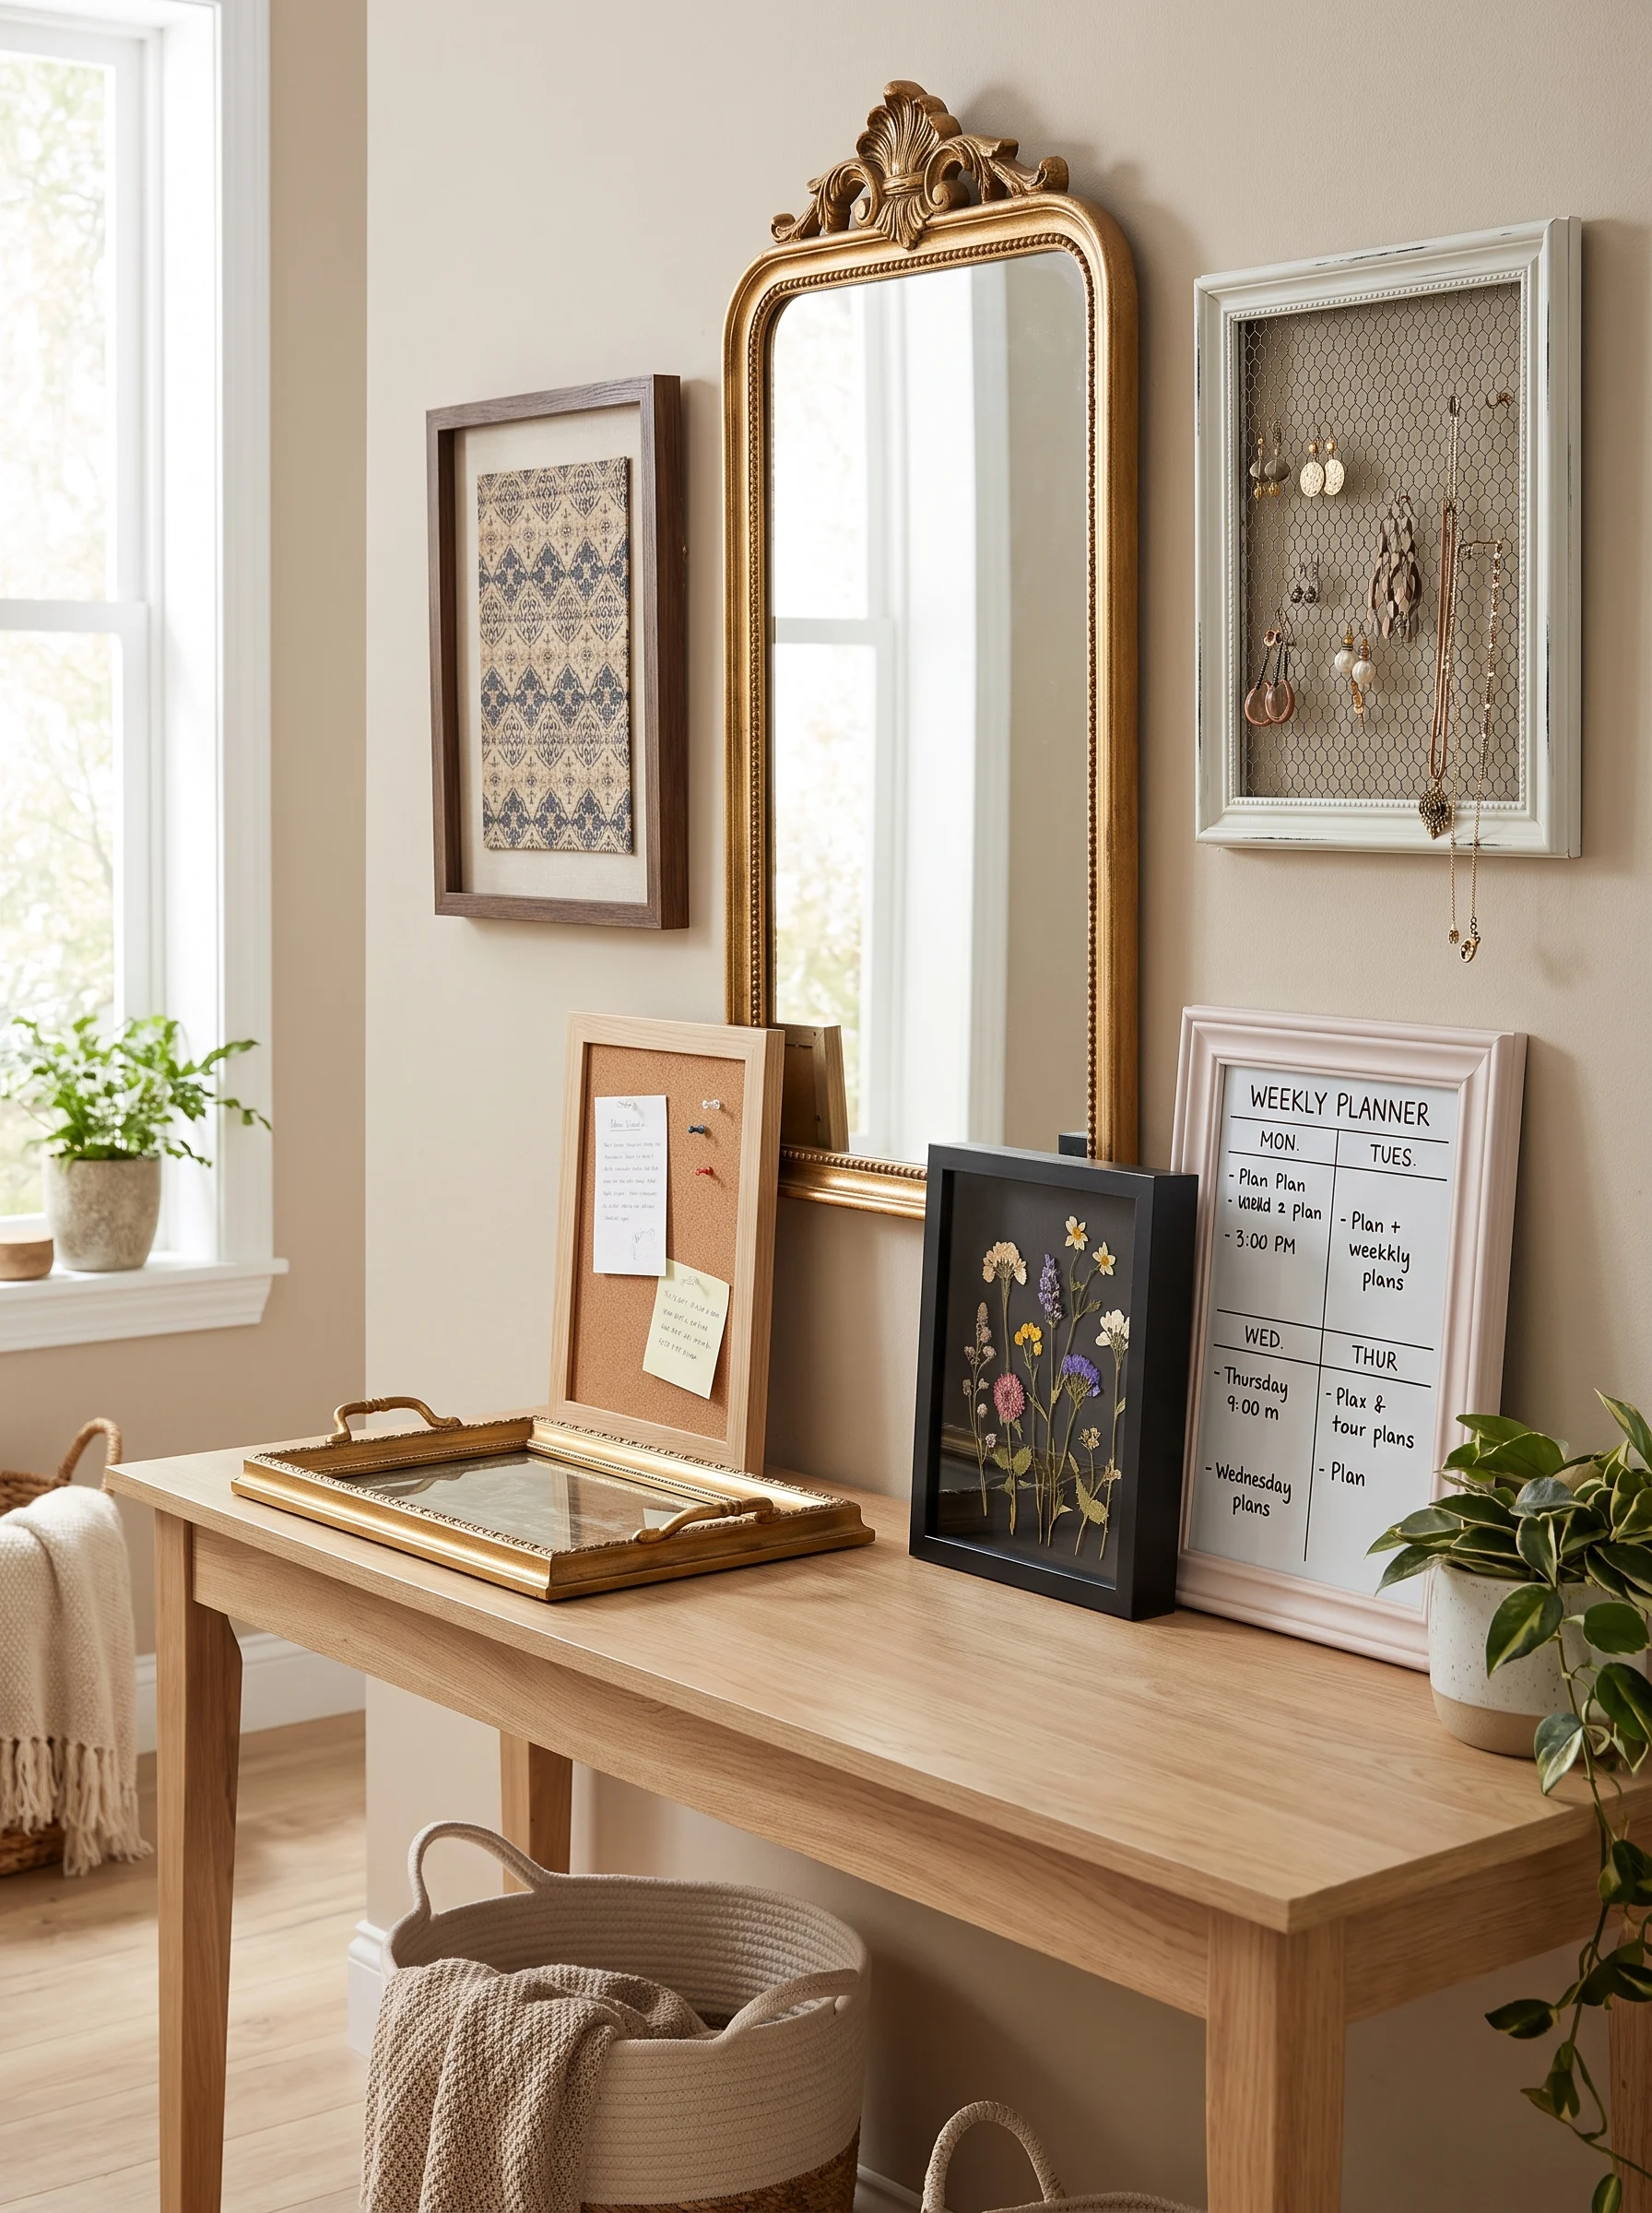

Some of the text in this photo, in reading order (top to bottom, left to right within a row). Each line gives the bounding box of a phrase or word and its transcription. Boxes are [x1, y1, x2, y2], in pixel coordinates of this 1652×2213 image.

[1250, 1083, 1431, 1128] WEEKLY PLANNER
[1259, 1130, 1301, 1153] MON.
[1369, 1143, 1418, 1168] TUES.
[1238, 1167, 1268, 1189] Plan
[1275, 1172, 1305, 1193] Plan
[1277, 1201, 1287, 1214] 2
[1351, 1210, 1384, 1234] Plan
[1235, 1229, 1268, 1250] 3:00
[1274, 1235, 1296, 1255] PM
[1349, 1243, 1410, 1274] weekkly
[1362, 1268, 1404, 1292] plans
[1245, 1324, 1285, 1351] WED.
[1351, 1344, 1398, 1372] THUR
[1223, 1366, 1289, 1404] Thursday
[1226, 1394, 1280, 1421] 9:00 m
[1336, 1386, 1367, 1409] Plax
[1374, 1394, 1386, 1414] &
[1331, 1414, 1415, 1450] tour plans
[1215, 1462, 1292, 1505] Wednesday
[1330, 1461, 1365, 1487] Plan
[1232, 1493, 1270, 1518] plans
